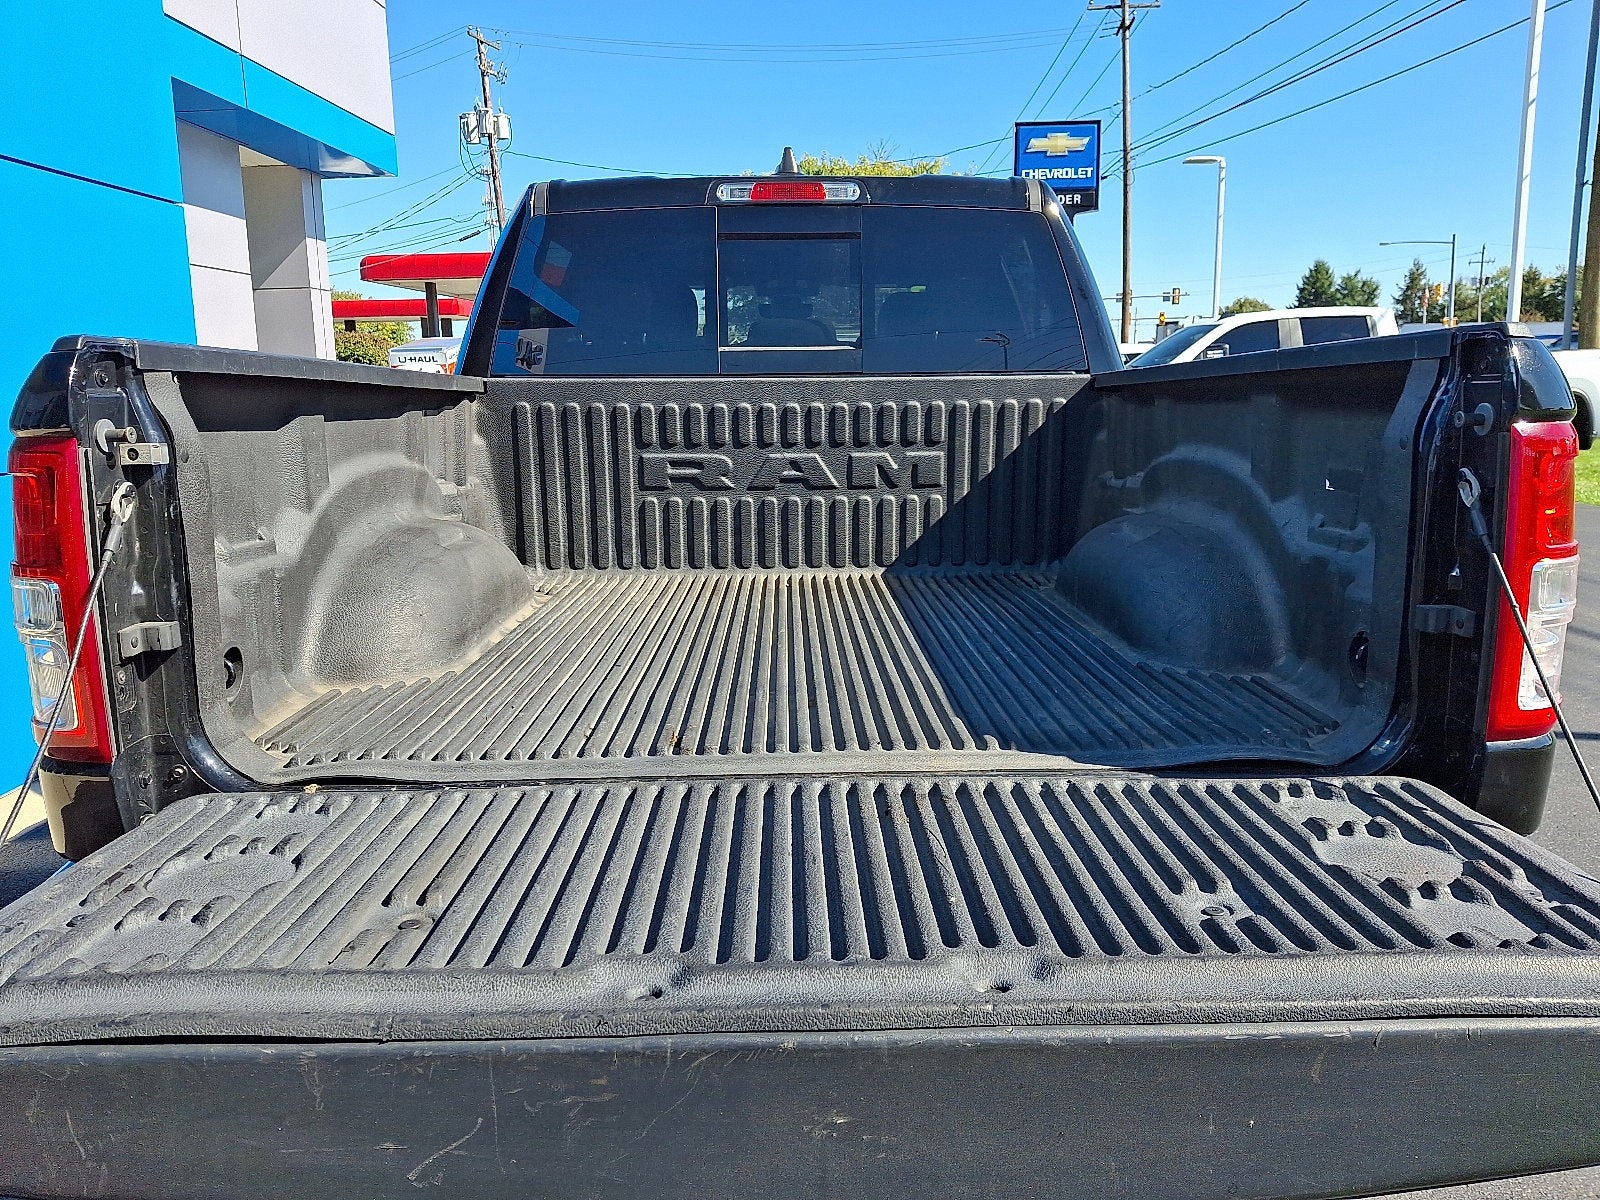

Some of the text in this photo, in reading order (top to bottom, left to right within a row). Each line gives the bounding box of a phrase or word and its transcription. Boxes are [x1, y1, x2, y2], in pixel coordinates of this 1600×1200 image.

[1021, 167, 1094, 180] CHEVROLET
[398, 355, 438, 364] U-HAUL
[638, 451, 945, 491] RAM
